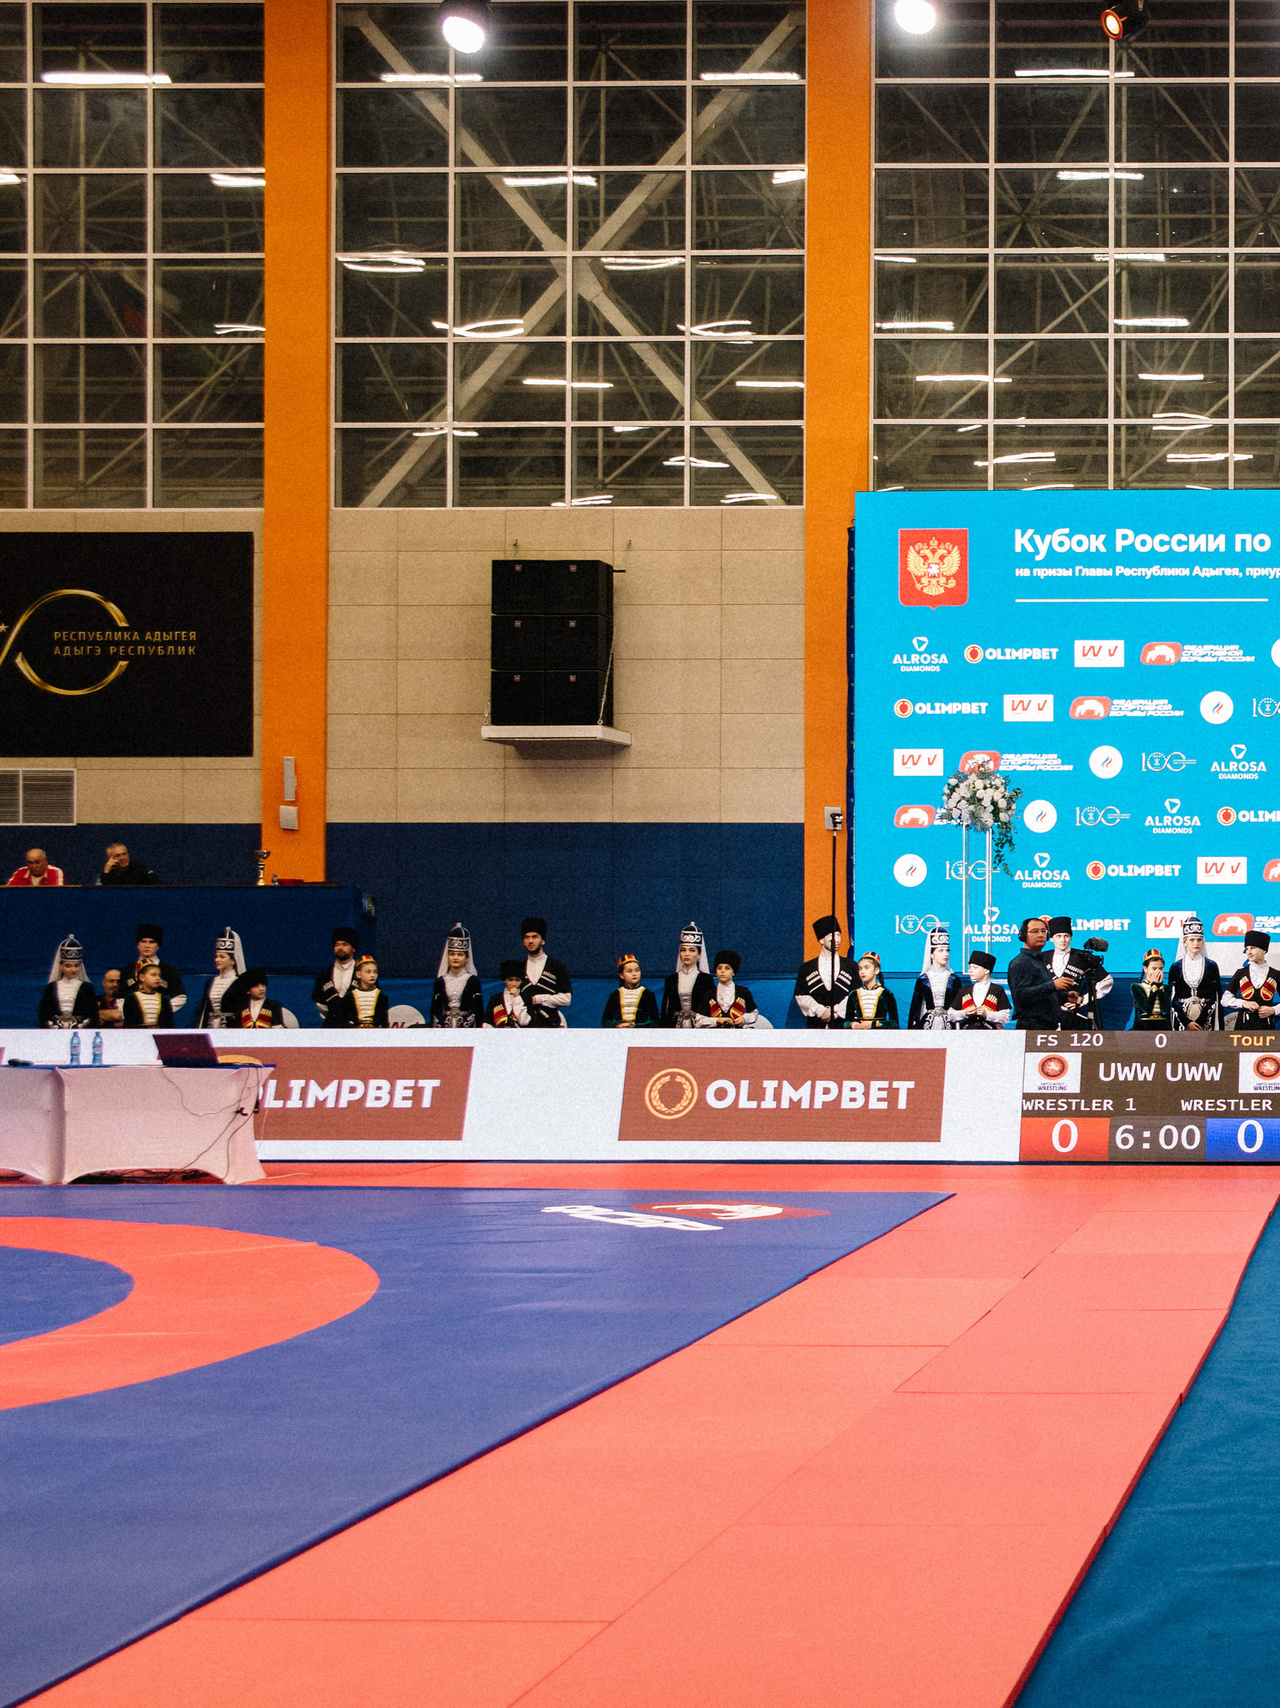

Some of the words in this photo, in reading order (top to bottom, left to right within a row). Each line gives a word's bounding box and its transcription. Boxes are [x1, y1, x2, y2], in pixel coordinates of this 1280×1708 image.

[1015, 528, 1106, 561] Кубок
[1116, 529, 1225, 552] России
[1235, 534, 1271, 552] по
[1015, 568, 1030, 576] на
[1033, 568, 1072, 579] призы
[1075, 566, 1112, 576] Главы
[1116, 565, 1190, 579] Республики
[1192, 566, 1243, 577] Адыгея,
[54, 631, 140, 641] РЕСПУБЛИКА
[145, 631, 197, 642] АДЫГЕЯ
[54, 646, 102, 656] АДЫГЭ
[110, 646, 196, 656] РЕСПУБЛИК
[985, 648, 1059, 660] OLIMPBET
[892, 653, 949, 664] ALROSA
[915, 702, 989, 714] OLIMPBET
[1210, 761, 1267, 772] ALROSA
[1144, 815, 1201, 826] ALROSA
[1014, 869, 1071, 880] ALROSA
[1107, 865, 1181, 877] OLIMPBET
[1072, 918, 1131, 931] LIMPBET
[1037, 1034, 1058, 1046] FS
[1071, 1034, 1103, 1046] 120
[1155, 1034, 1167, 1048] 0
[1230, 1034, 1275, 1046] Tour
[1099, 1062, 1156, 1081] UWW
[1166, 1062, 1223, 1081] UWW
[258, 1079, 441, 1108] LIMPBET
[705, 1079, 915, 1110] OLIMPBET
[1022, 1099, 1114, 1111] WRESTLER
[1126, 1099, 1136, 1111] 1
[1181, 1099, 1272, 1111] WRESTLER
[1052, 1120, 1078, 1153] 0
[1115, 1125, 1200, 1150] 6:00
[1237, 1120, 1264, 1153] 0
